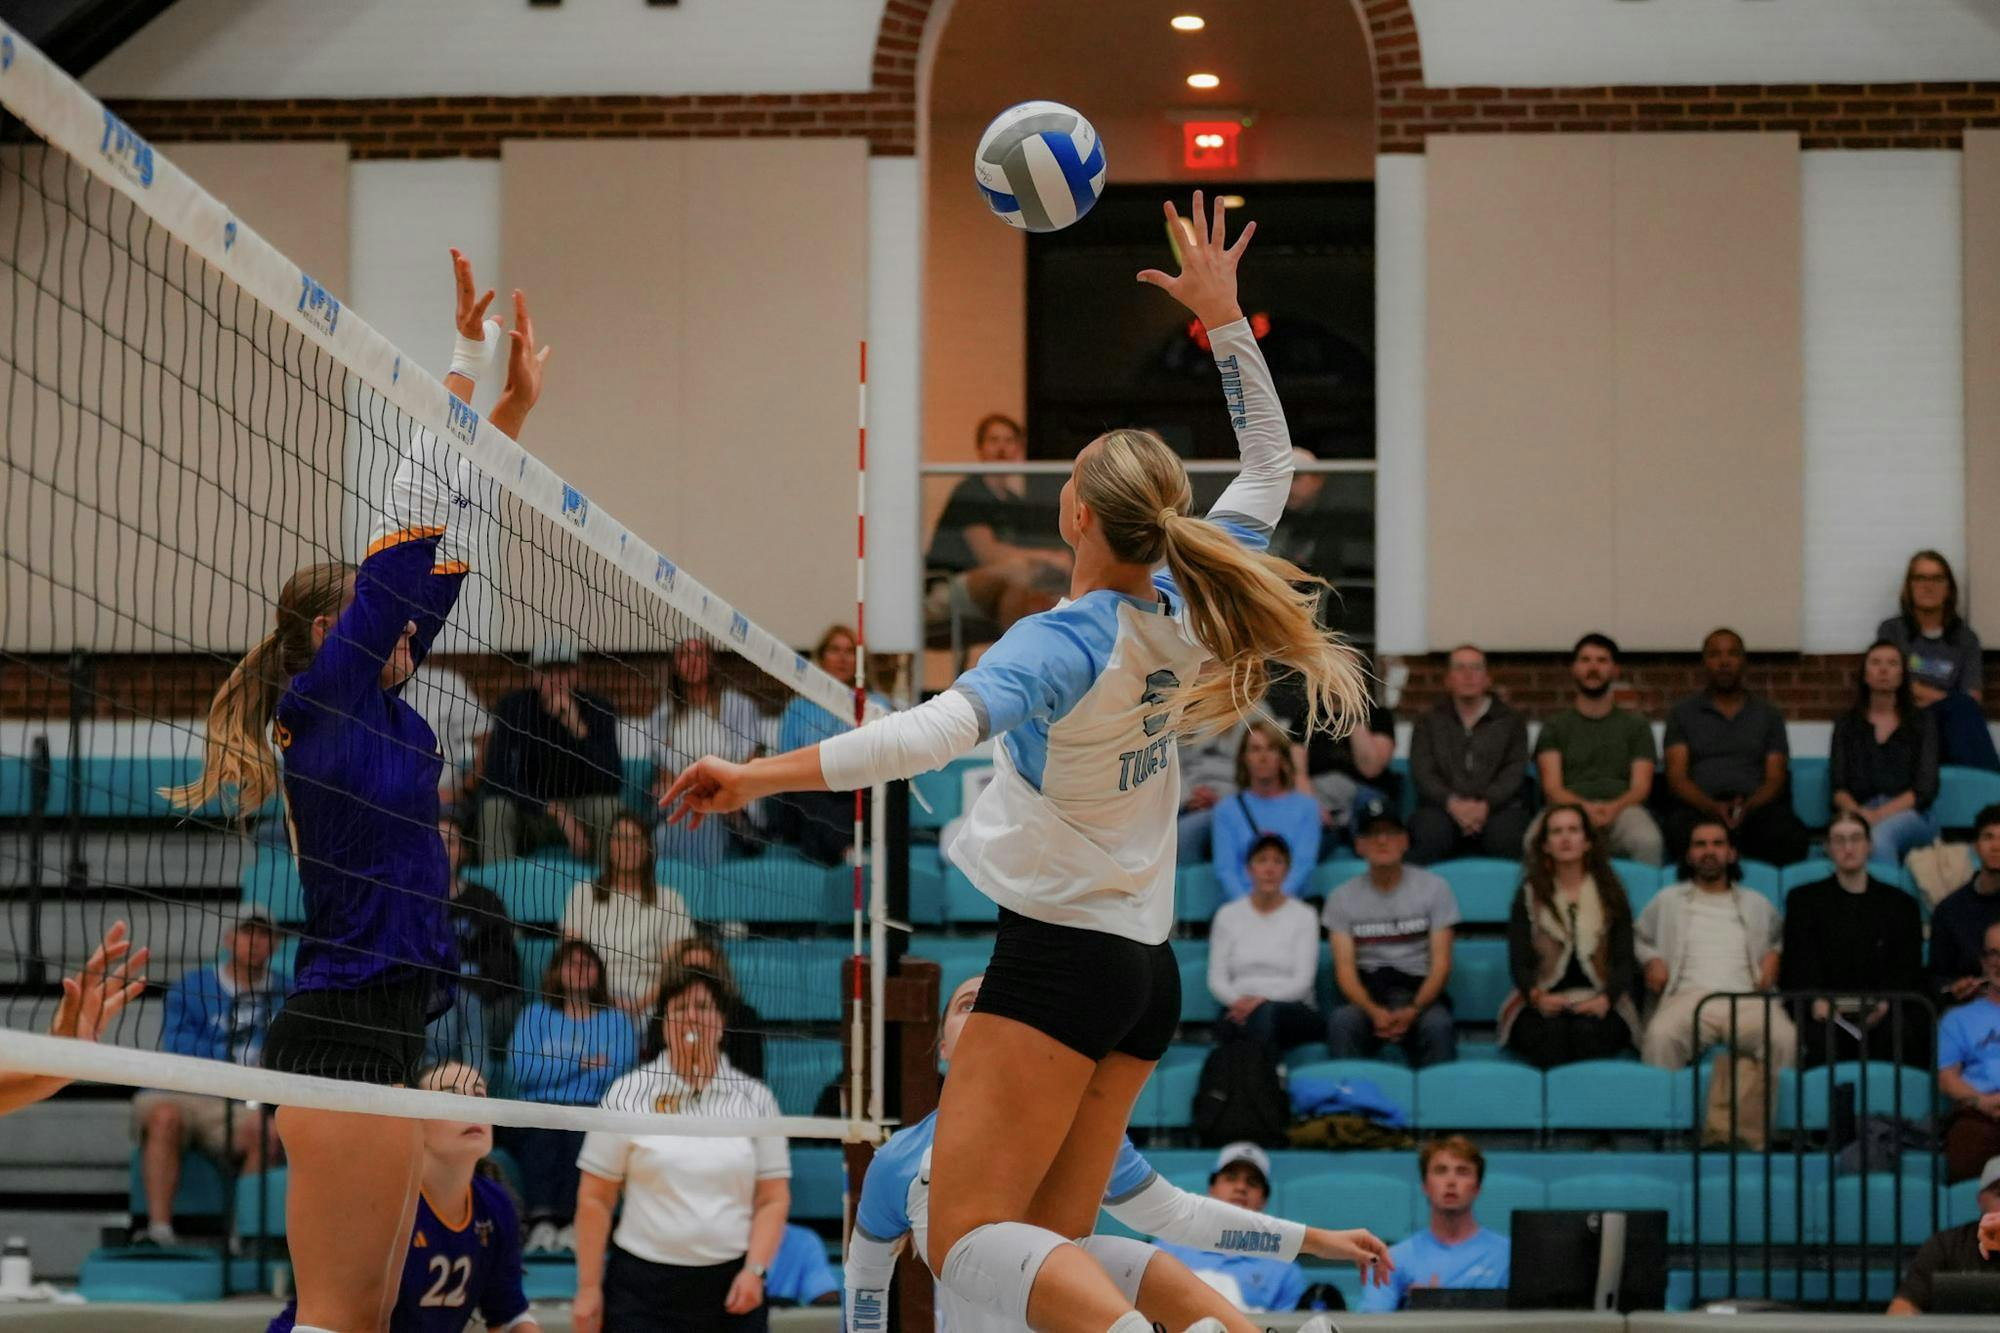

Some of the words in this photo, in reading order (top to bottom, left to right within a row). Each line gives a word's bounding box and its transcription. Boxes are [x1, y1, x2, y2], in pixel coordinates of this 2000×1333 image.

[1119, 731, 1176, 791] TUFT
[1214, 1230, 1282, 1253] JUMBOS
[419, 1254, 473, 1308] 22
